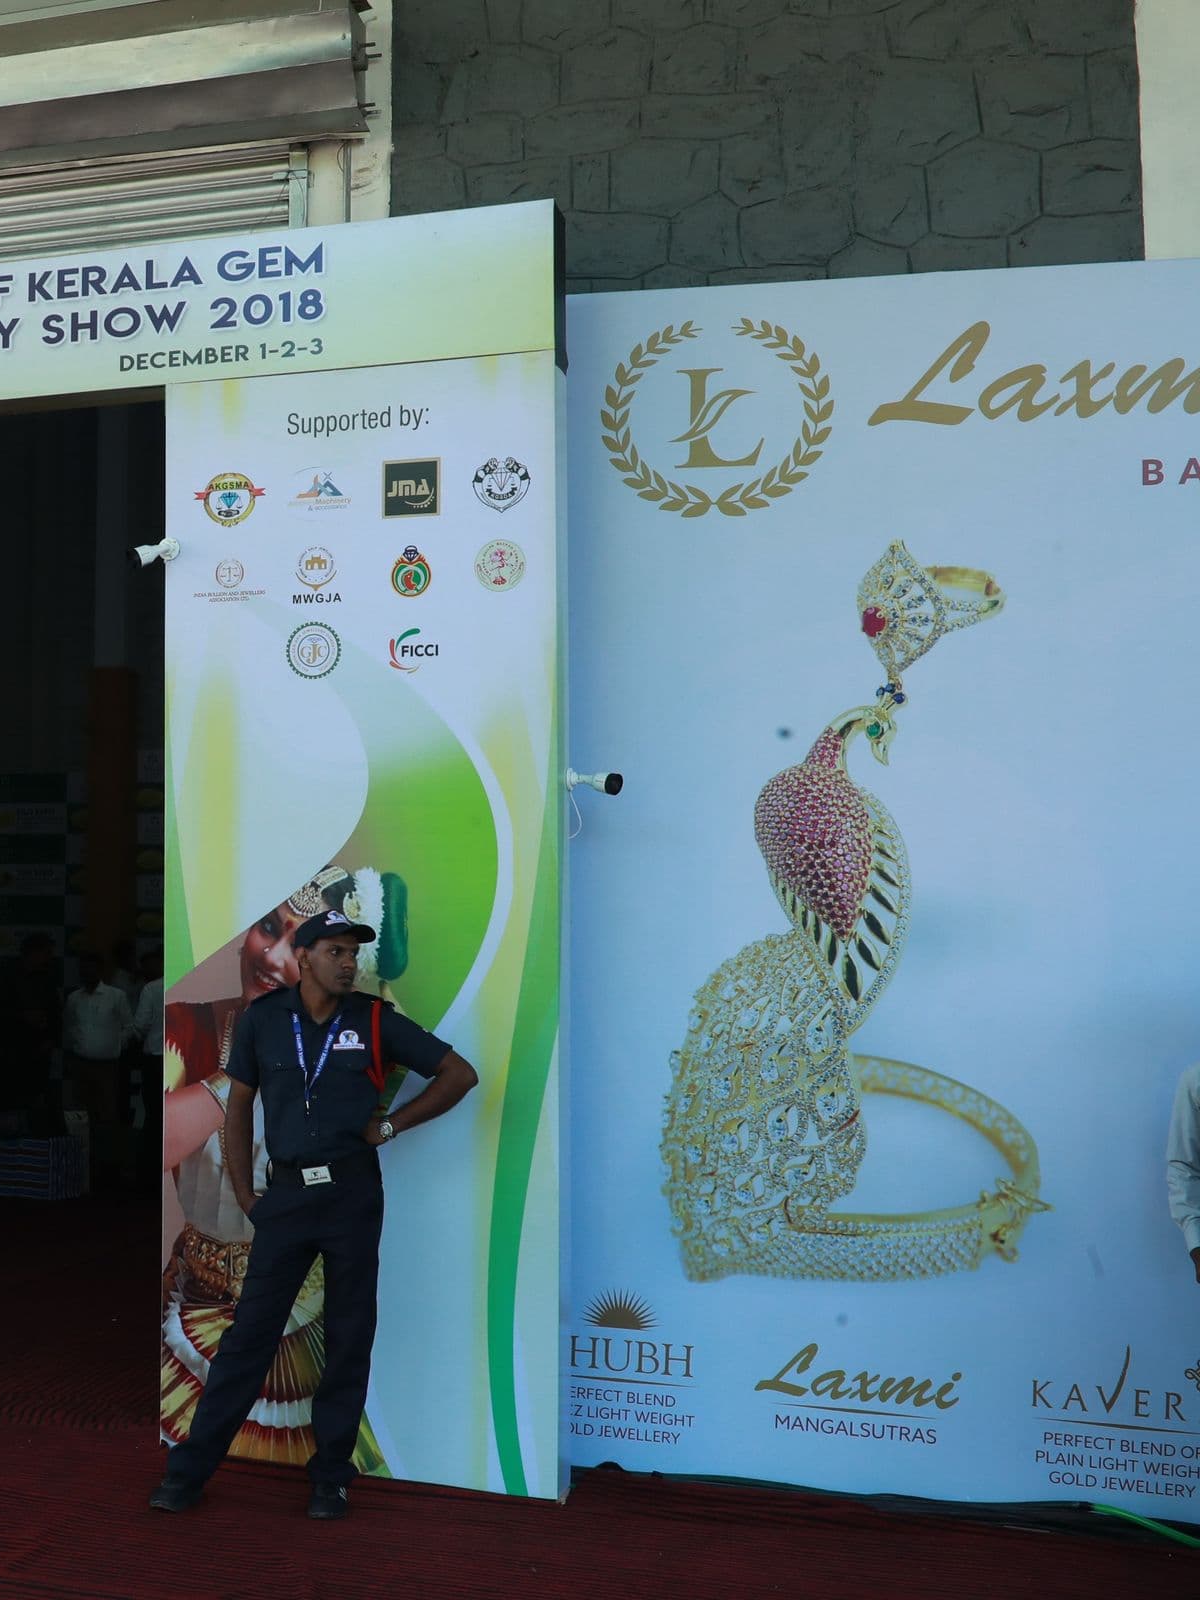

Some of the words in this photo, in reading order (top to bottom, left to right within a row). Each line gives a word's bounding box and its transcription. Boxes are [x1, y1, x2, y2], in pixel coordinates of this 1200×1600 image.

[27, 255, 203, 302] KERALA
[217, 241, 324, 282] GEM
[42, 301, 187, 345] SHOW
[209, 288, 325, 329] 2018
[119, 344, 250, 372] DECEMBER
[260, 338, 324, 361] 1-2-3
[287, 405, 391, 438] Supported
[399, 405, 429, 431] by:
[208, 480, 249, 491] AKGSMA
[387, 478, 431, 497] JMA
[292, 593, 342, 604] MWGJA
[401, 644, 439, 658] FICCI
[570, 1335, 695, 1378] HUBH
[754, 1342, 962, 1410] Laxmi
[1031, 1344, 1187, 1422] KAVER
[627, 1391, 676, 1408] BLEND
[587, 1406, 631, 1421] LIGHT
[635, 1410, 695, 1428] WEIGHT
[774, 1414, 937, 1445] MANGALSUTRAS
[598, 1424, 681, 1445] JEWELLERY
[1043, 1432, 1115, 1450] PERFECT
[1120, 1440, 1176, 1457] BLEND
[1035, 1450, 1084, 1468] PLAIN
[1089, 1457, 1138, 1473] LIGHT
[1049, 1471, 1097, 1488] GOLD
[1101, 1476, 1196, 1498] JEWELLERY
